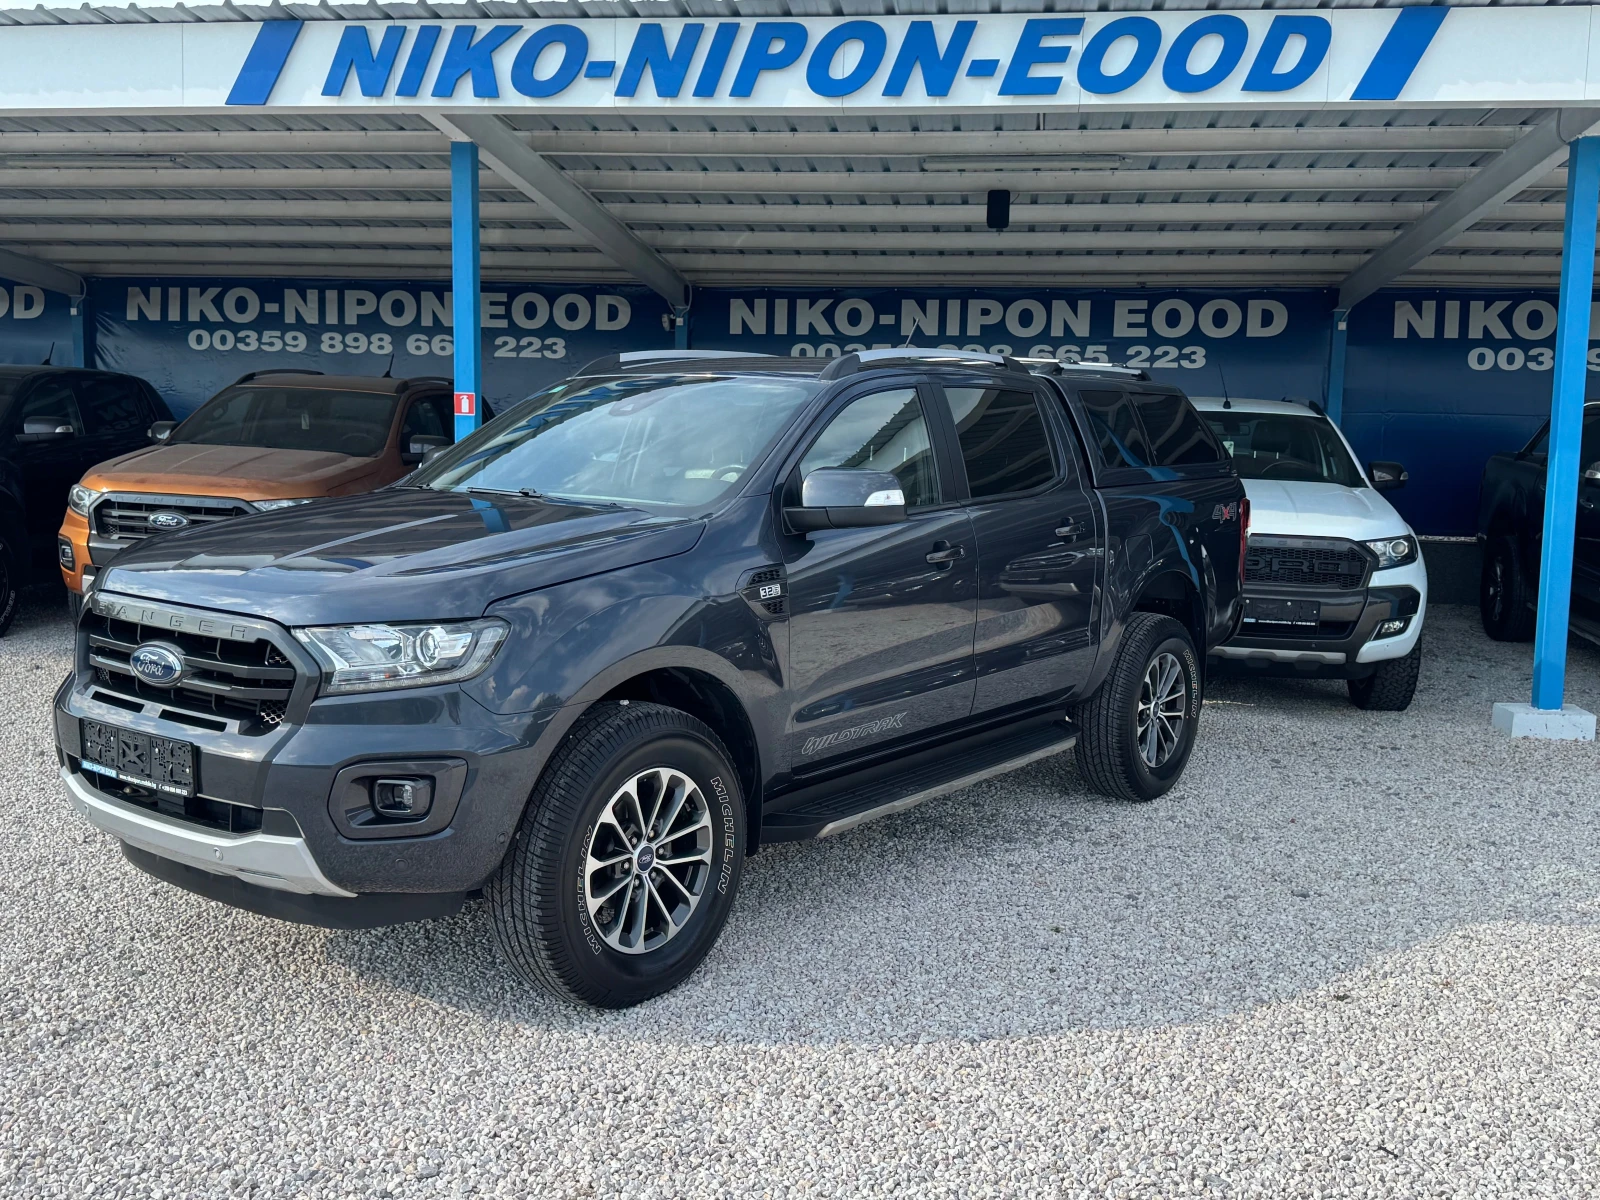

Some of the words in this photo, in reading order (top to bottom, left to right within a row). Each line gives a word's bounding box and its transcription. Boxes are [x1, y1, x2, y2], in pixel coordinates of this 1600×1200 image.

[321, 14, 1333, 98] NIKO-NIPON-EOOD
[126, 287, 453, 327] NIKO-NIPON
[480, 292, 631, 331] EOOD
[729, 298, 1092, 338] NIKO-NIPON
[1113, 298, 1288, 338] EOOD
[1393, 300, 1600, 340] NIKO
[188, 329, 307, 353] 00359
[320, 332, 393, 355] 898
[406, 333, 454, 356] 66
[494, 336, 567, 359] 223
[1126, 345, 1206, 369] 223
[156, 515, 178, 526] Ford
[97, 600, 248, 639] RANGER
[136, 651, 165, 677] Ford
[802, 712, 908, 755] WILDTRAK
[711, 776, 735, 895] MICHELIN
[576, 824, 602, 955] MICHELIN
